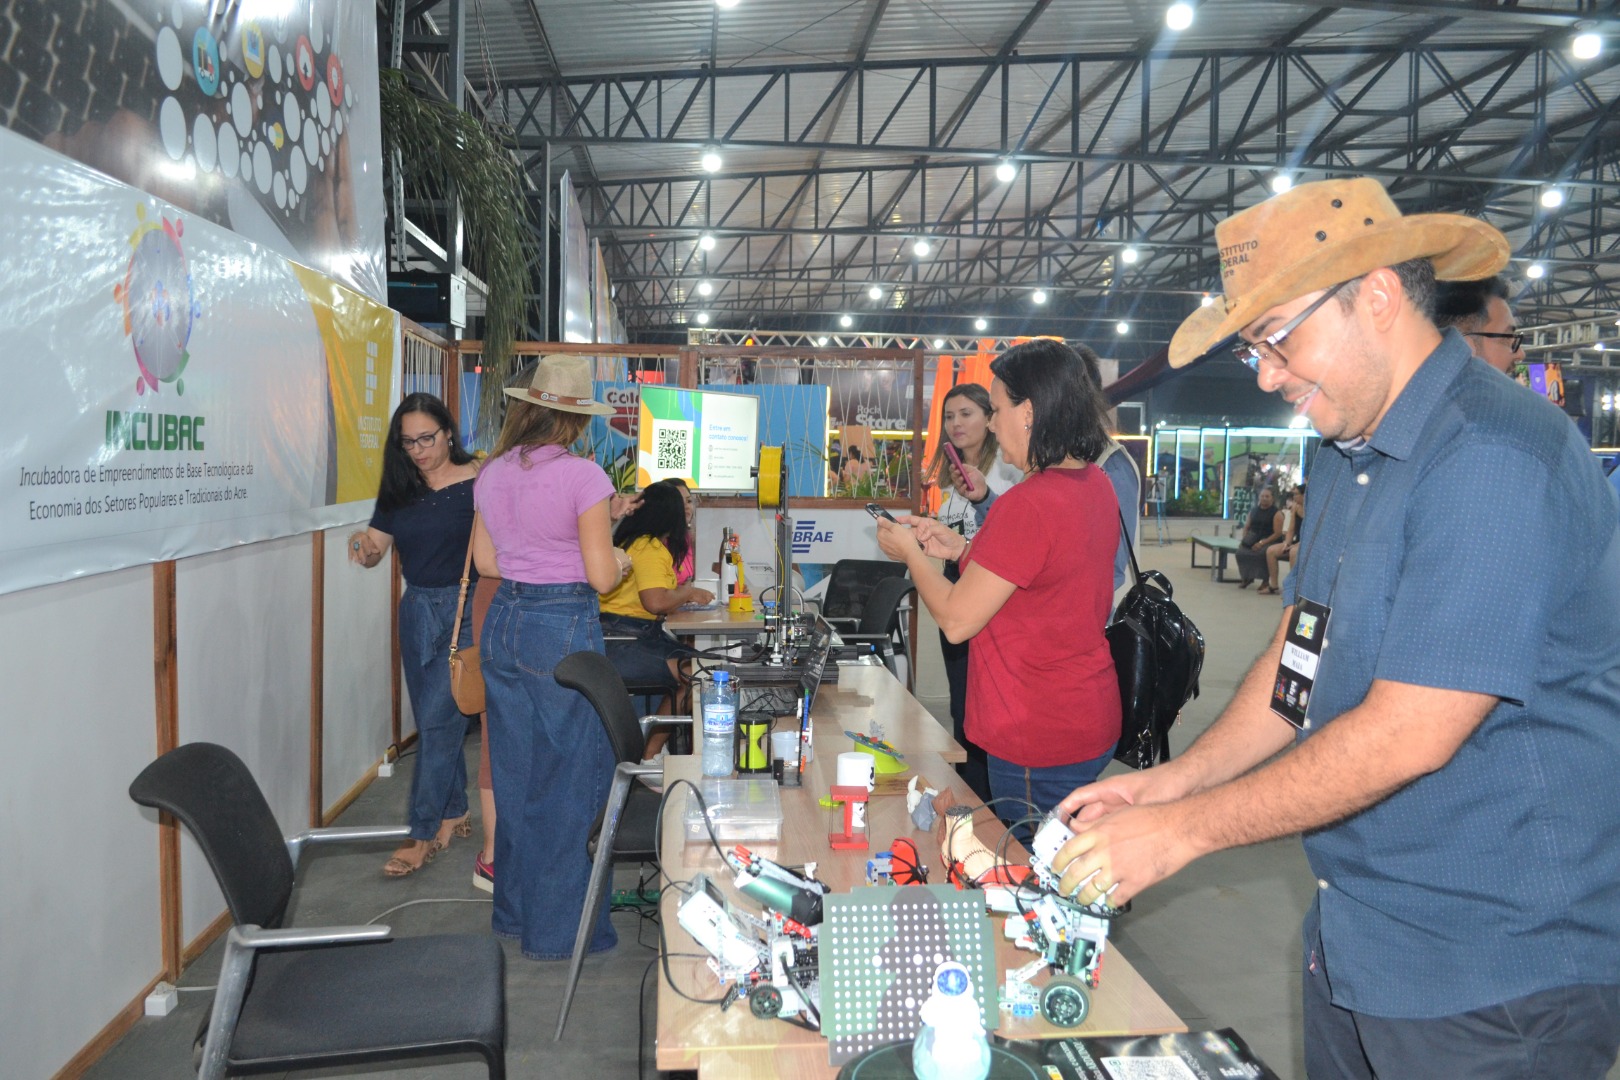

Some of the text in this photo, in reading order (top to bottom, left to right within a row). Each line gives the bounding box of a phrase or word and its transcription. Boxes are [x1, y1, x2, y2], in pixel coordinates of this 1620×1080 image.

[857, 405, 881, 415] Rock
[105, 410, 205, 451] INCUBAC
[856, 414, 906, 430] Store
[20, 461, 254, 486] Incubadora de Empreendimentos de Base Tecnológica e da
[29, 485, 248, 520] Economia dos Setores Populares e Tradicionais do Acre.
[792, 532, 834, 543] BRAE
